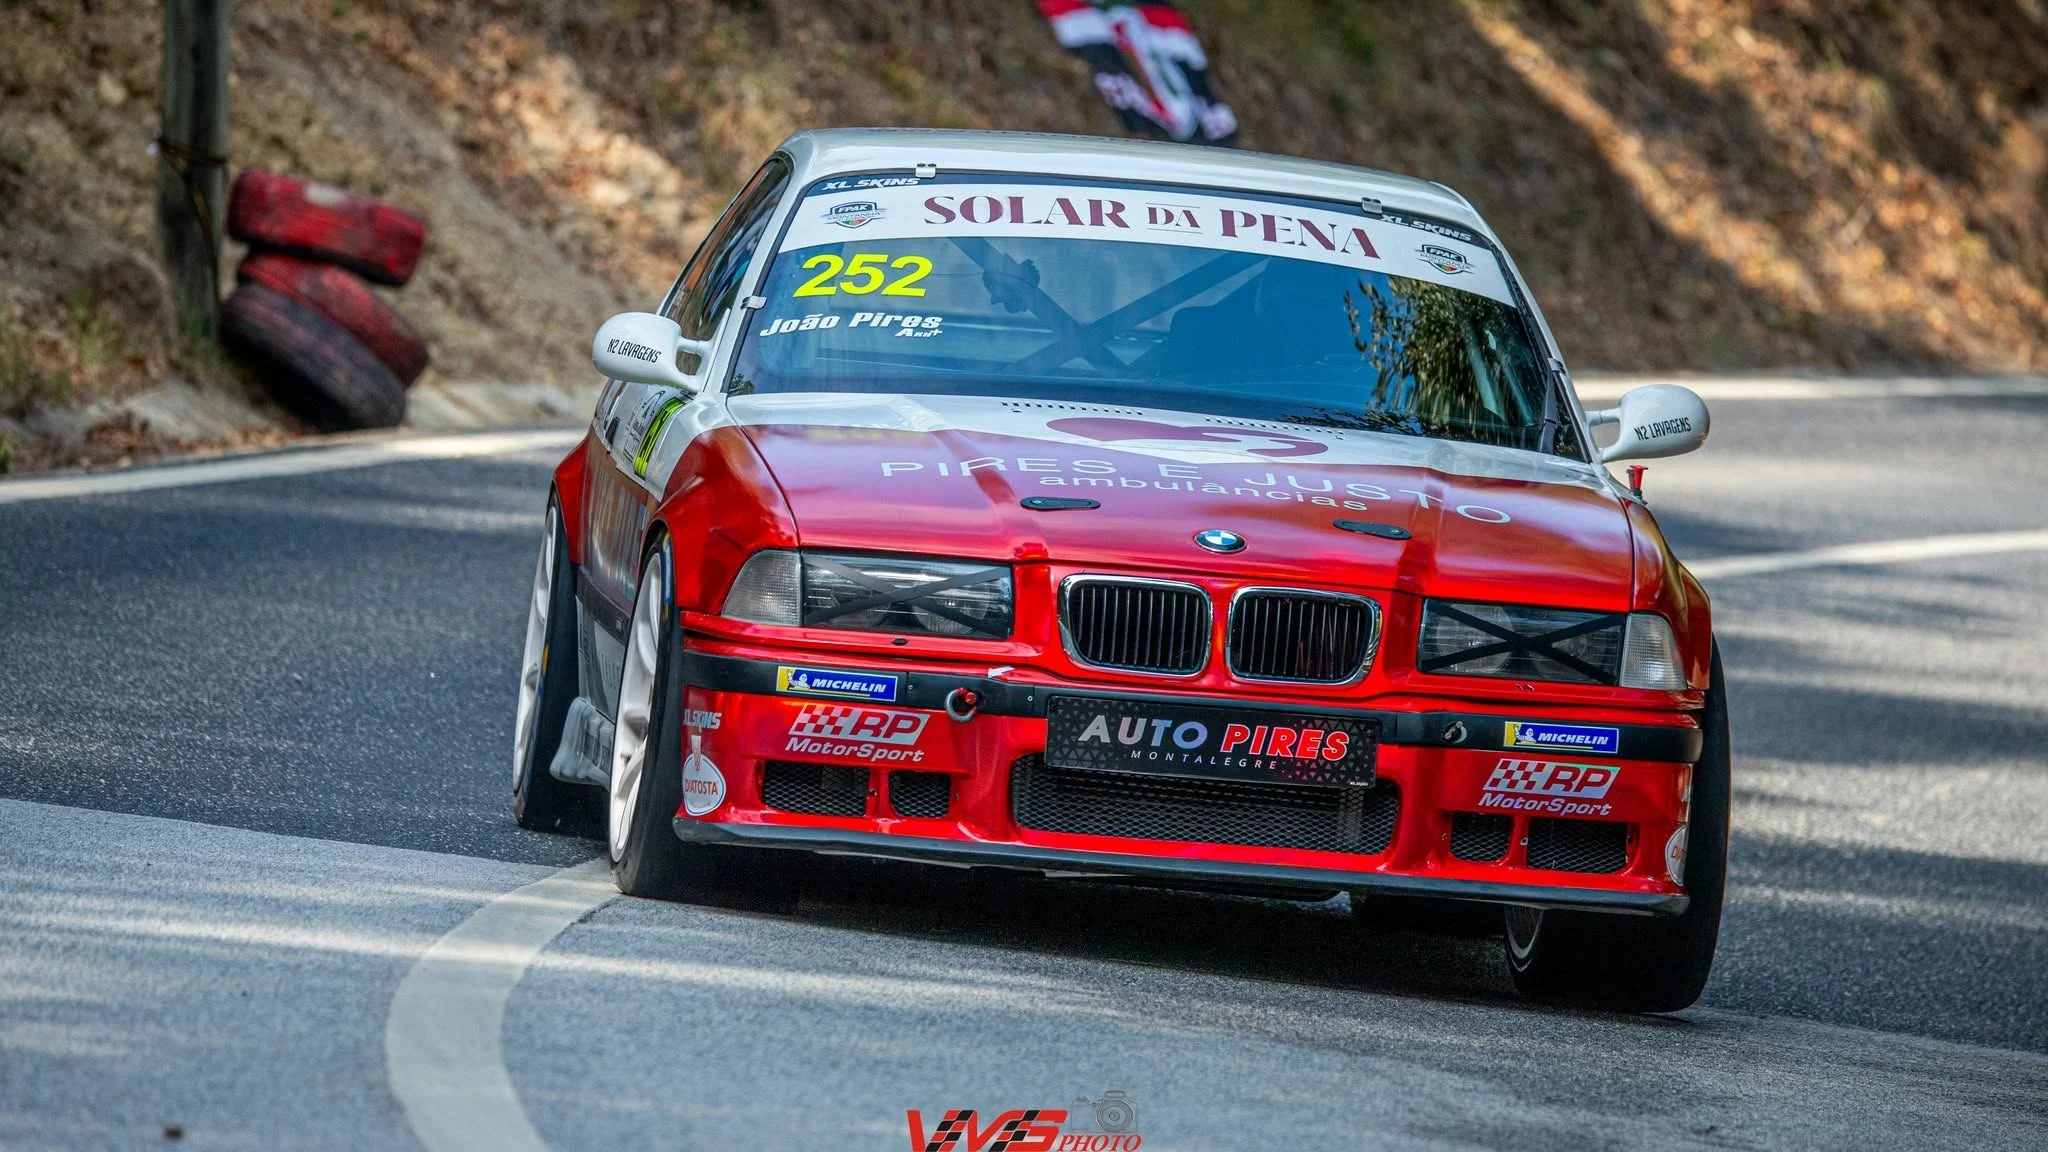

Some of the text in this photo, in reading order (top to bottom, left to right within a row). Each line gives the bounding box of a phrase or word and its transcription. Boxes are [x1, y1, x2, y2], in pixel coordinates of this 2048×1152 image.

[838, 204, 869, 213] FPAK
[924, 195, 1381, 260] SOLAR DA PENA
[1430, 248, 1459, 261] FPAK
[792, 253, 933, 298] 252
[759, 312, 943, 337] João Pires
[607, 338, 662, 363] N2 LAVAGENS
[1634, 416, 1692, 441] N2 LAVAGENS
[881, 456, 1512, 525] PIRES E JUSTO
[1039, 474, 1369, 512] ambulâncias
[811, 677, 888, 693] MICHELIN
[850, 710, 922, 739] RP
[785, 736, 925, 762] MotorSport
[1077, 714, 1350, 761] AUTO PIRES
[1537, 731, 1609, 746] MICHELIN
[1130, 749, 1277, 770] MONTALEGRE
[684, 779, 718, 796] DIATOSTA
[1541, 764, 1611, 793] RP
[1478, 791, 1613, 817] MotorSport
